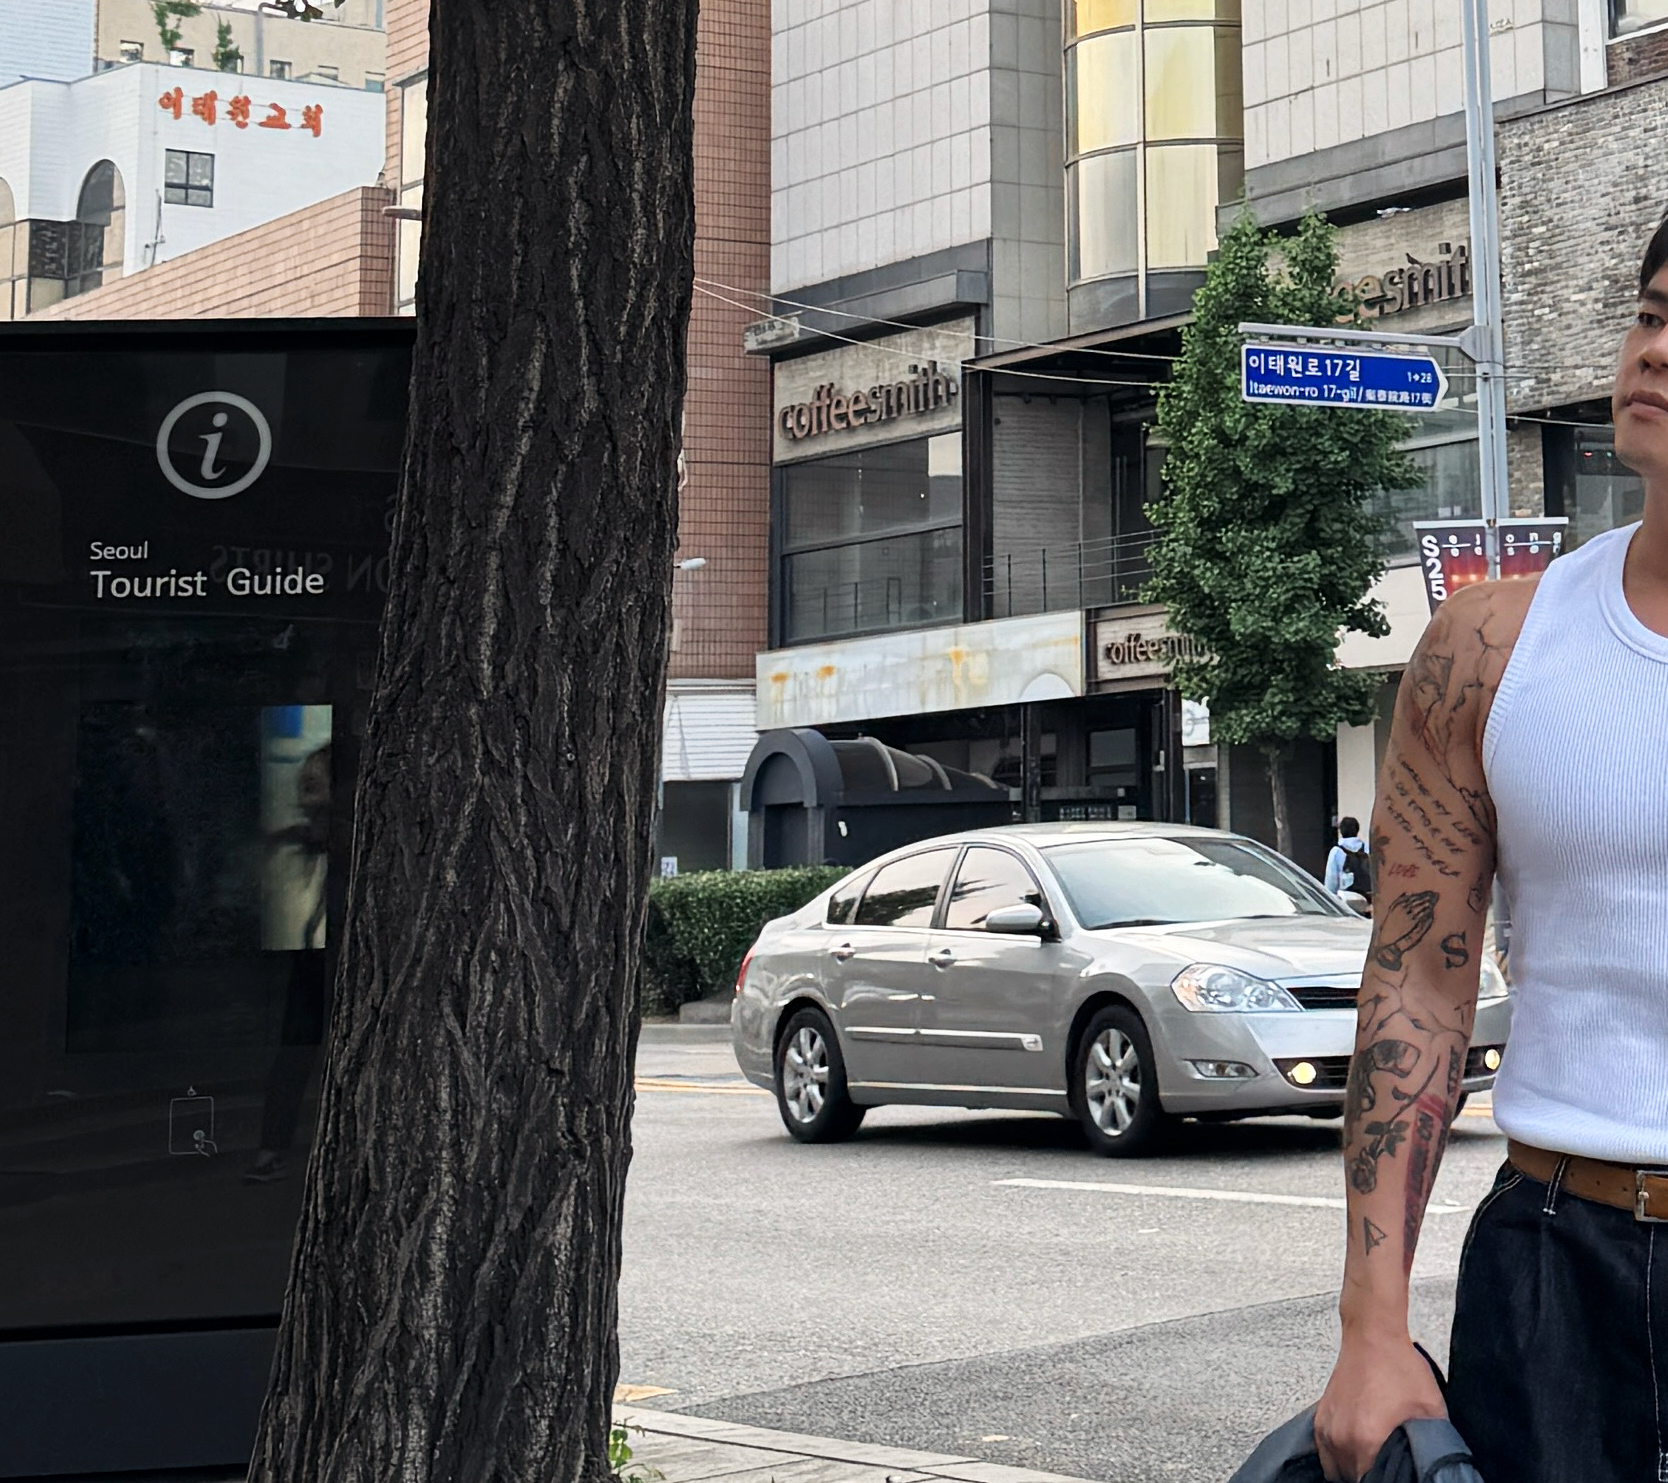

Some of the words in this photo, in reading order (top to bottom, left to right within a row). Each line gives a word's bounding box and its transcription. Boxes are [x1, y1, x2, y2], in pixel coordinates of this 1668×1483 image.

[158, 86, 324, 138] 이태원교회
[1249, 379, 1319, 399] Itaewon-ro
[90, 541, 149, 560] Seoul
[90, 569, 208, 598] Tourist
[226, 566, 325, 596] Guide
[1440, 931, 1469, 970] S
